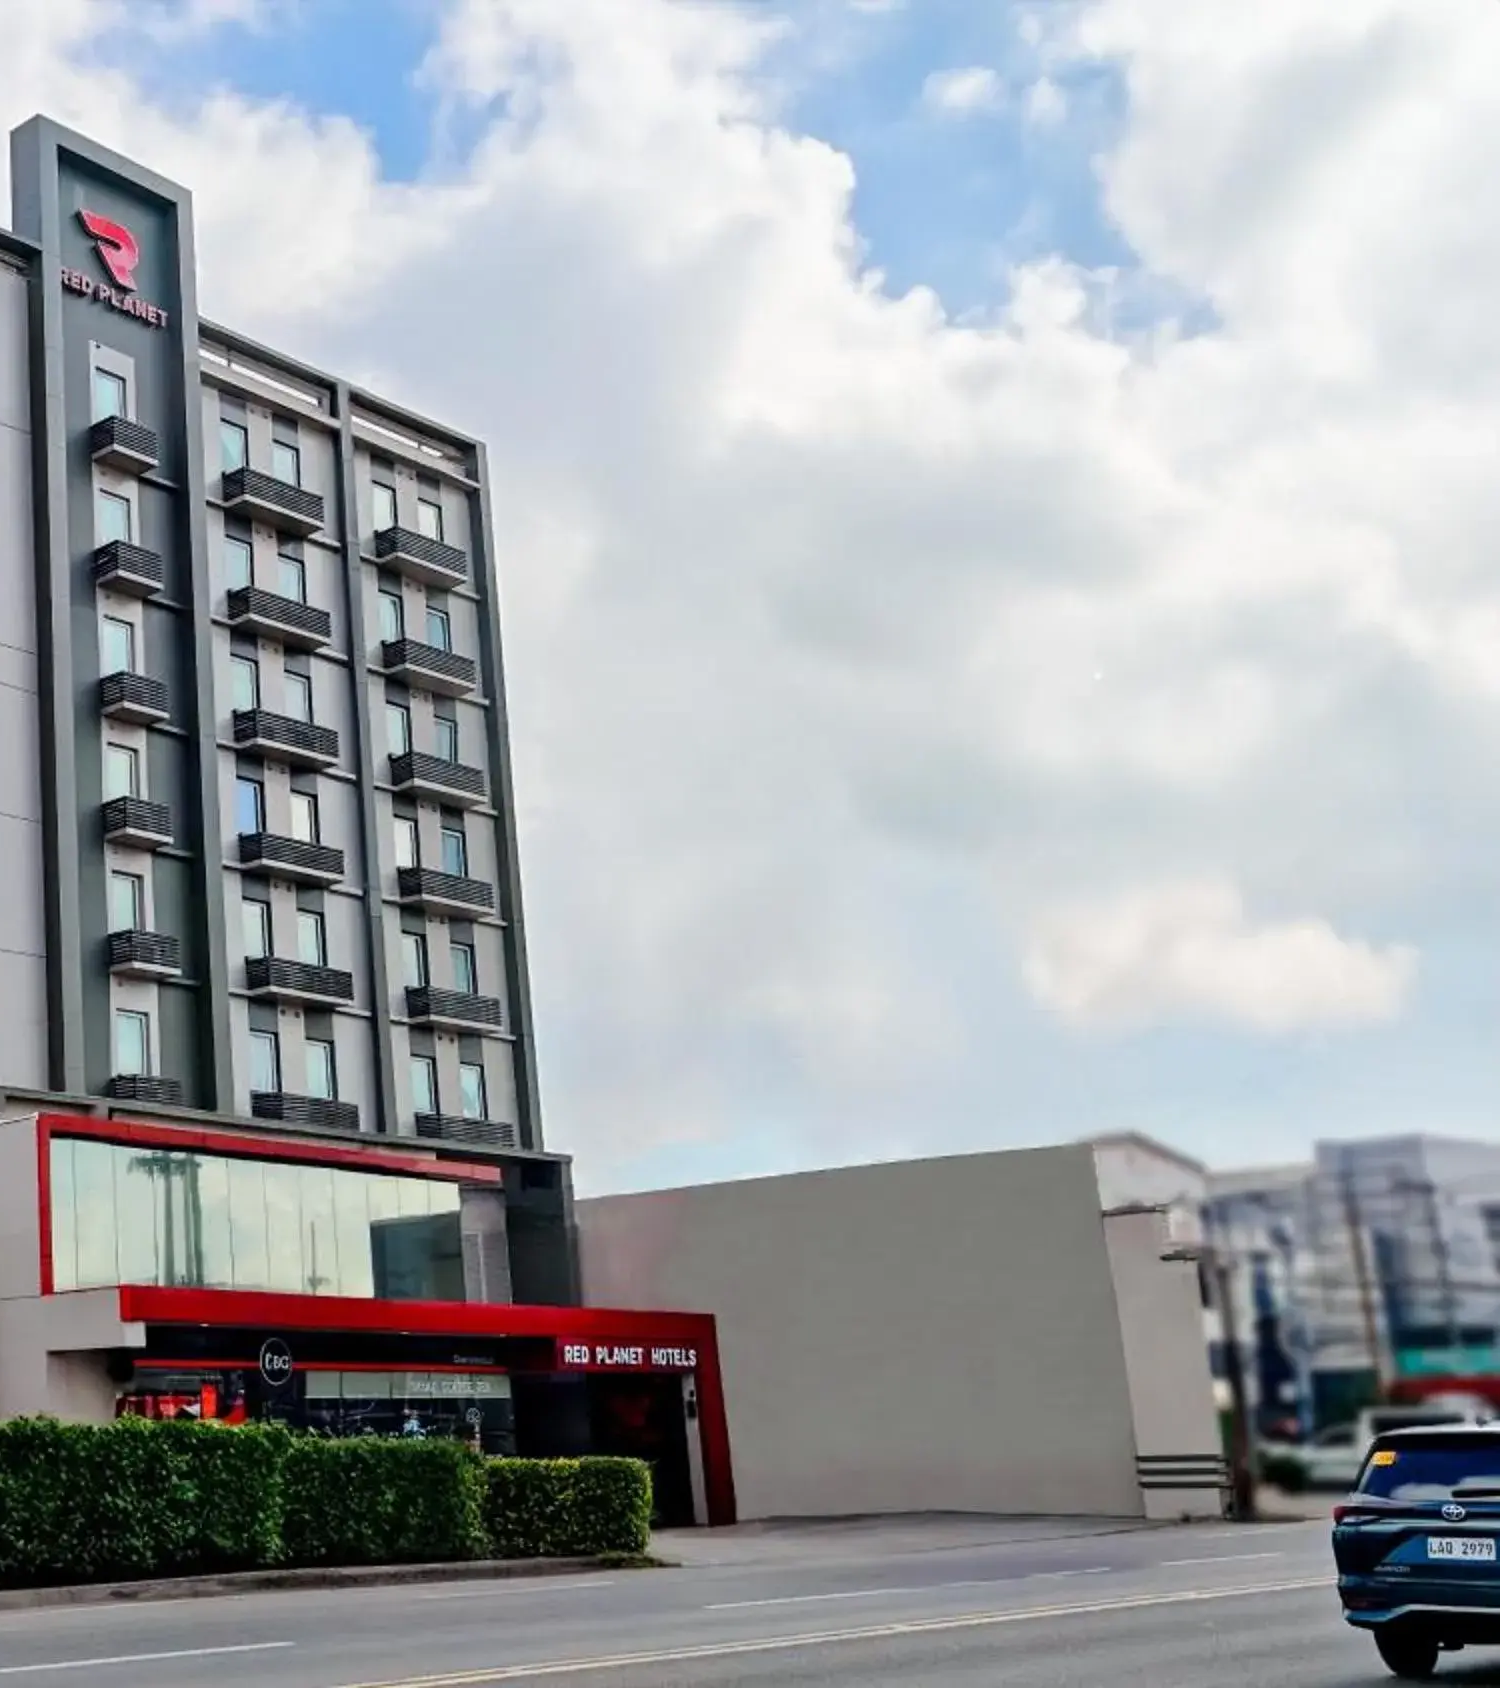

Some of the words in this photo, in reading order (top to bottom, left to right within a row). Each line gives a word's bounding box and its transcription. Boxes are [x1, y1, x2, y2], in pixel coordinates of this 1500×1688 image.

[61, 267, 94, 297] RED
[96, 283, 168, 329] PLANET
[564, 1344, 590, 1364] RED
[596, 1345, 644, 1365] PLANET
[651, 1347, 697, 1367] HOTELS
[1461, 1541, 1493, 1556] 2979
